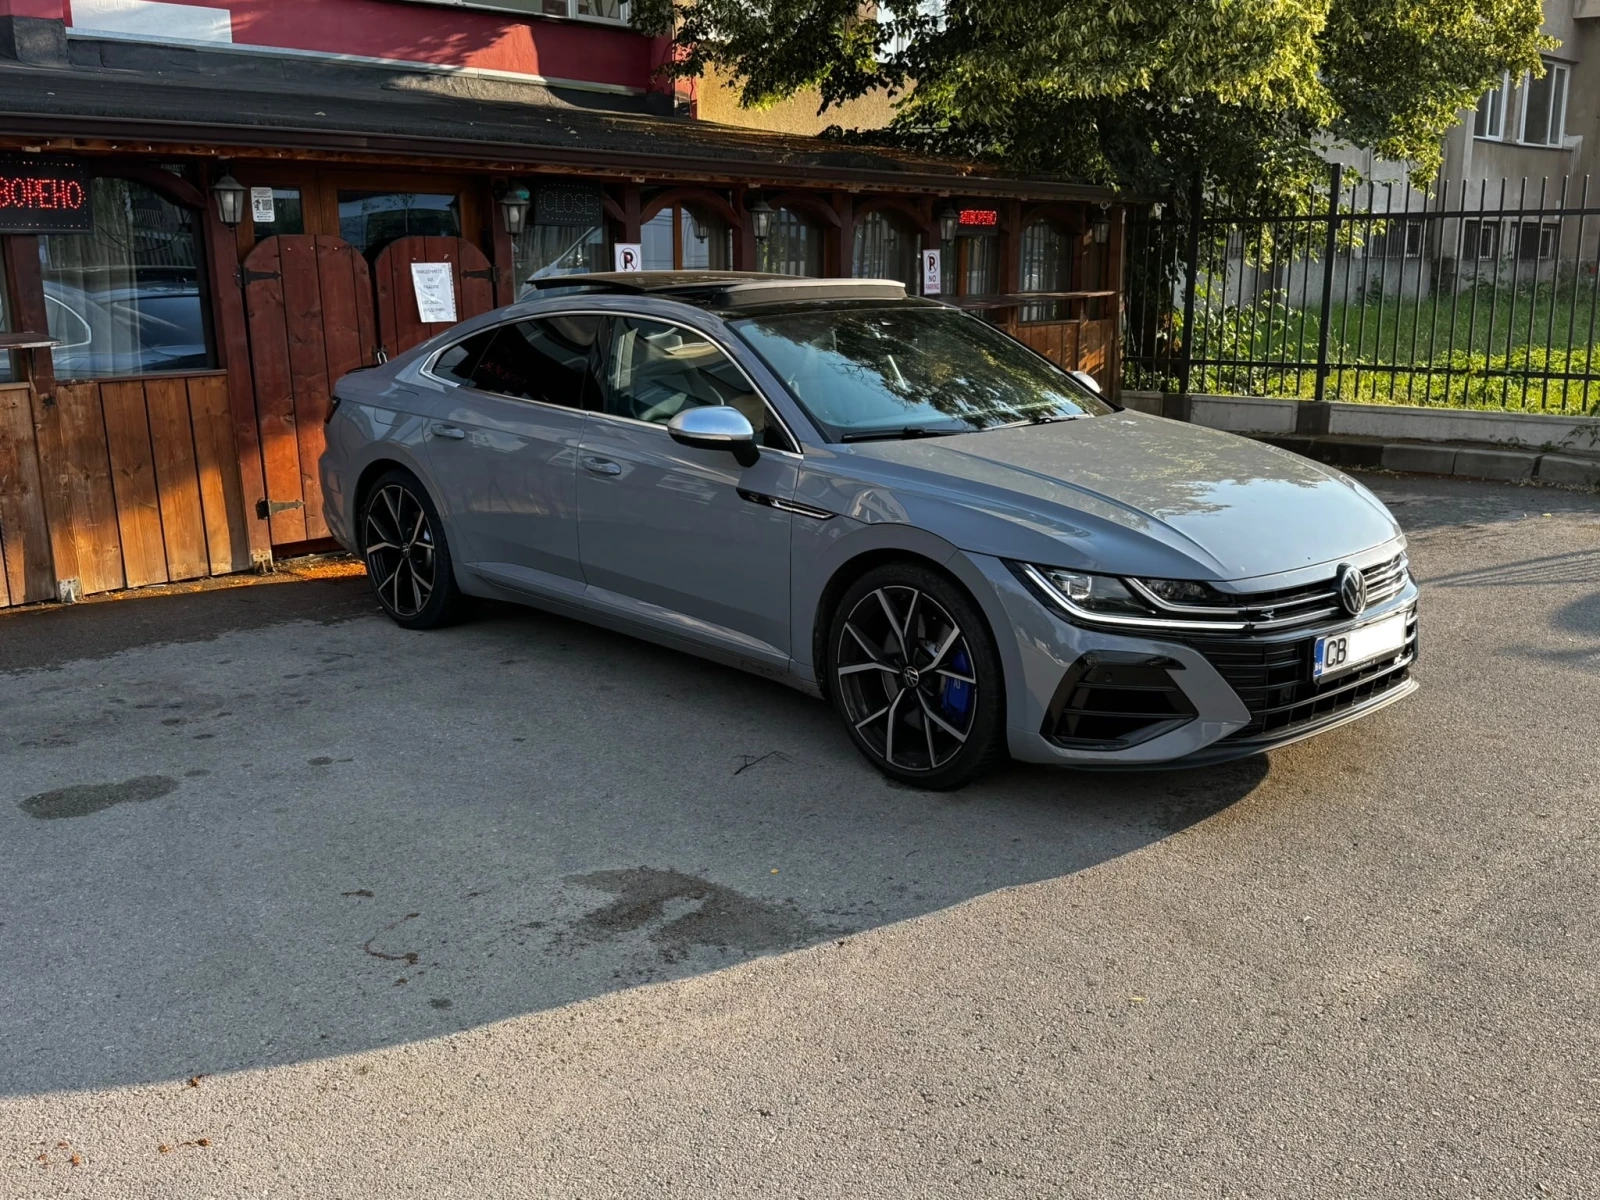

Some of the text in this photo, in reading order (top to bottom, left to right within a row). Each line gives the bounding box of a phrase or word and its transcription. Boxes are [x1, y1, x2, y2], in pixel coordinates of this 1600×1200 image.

[543, 190, 594, 215] CLOSE
[928, 274, 937, 283] NO
[1326, 637, 1347, 668] CB
[1314, 660, 1322, 672] BG
